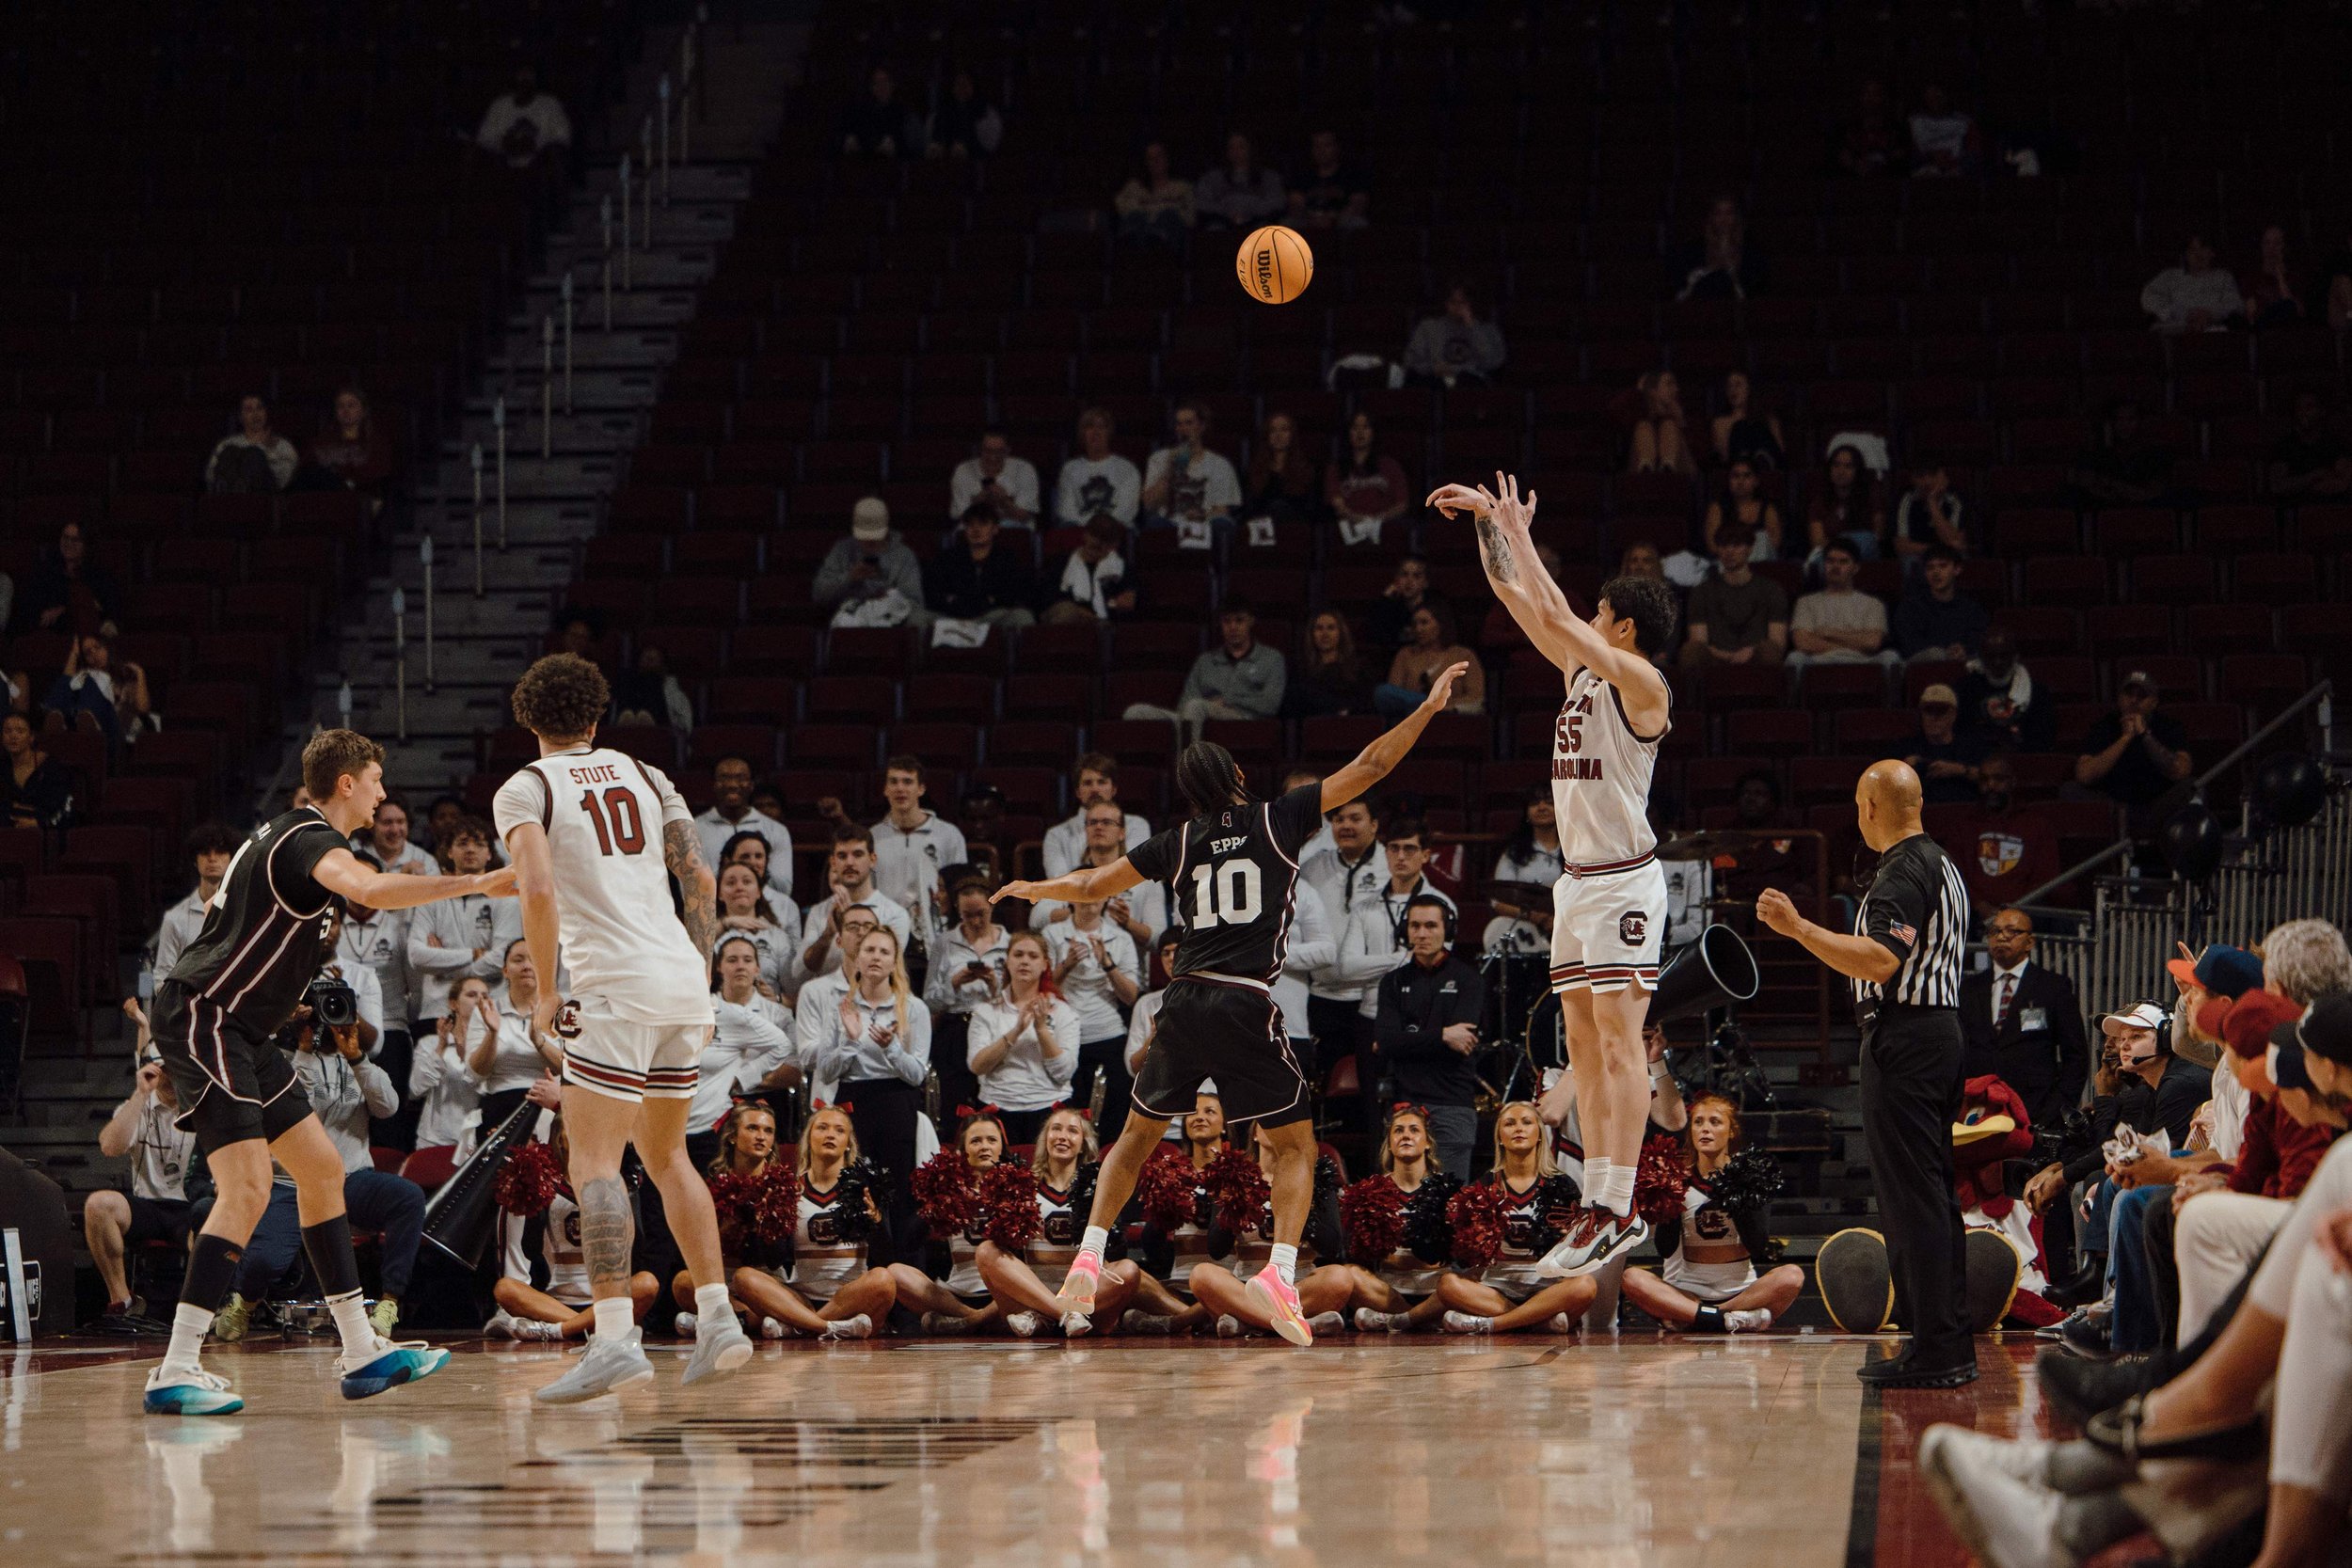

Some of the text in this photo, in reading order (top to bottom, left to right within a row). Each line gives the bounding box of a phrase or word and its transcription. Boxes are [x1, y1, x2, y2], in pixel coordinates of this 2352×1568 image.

[1257, 249, 1273, 298] Wilson
[1557, 716, 1582, 753] 55
[569, 765, 621, 784] STUTE
[1550, 758, 1603, 780] AROLINA
[580, 786, 646, 856] 10
[1191, 858, 1262, 930] 10
